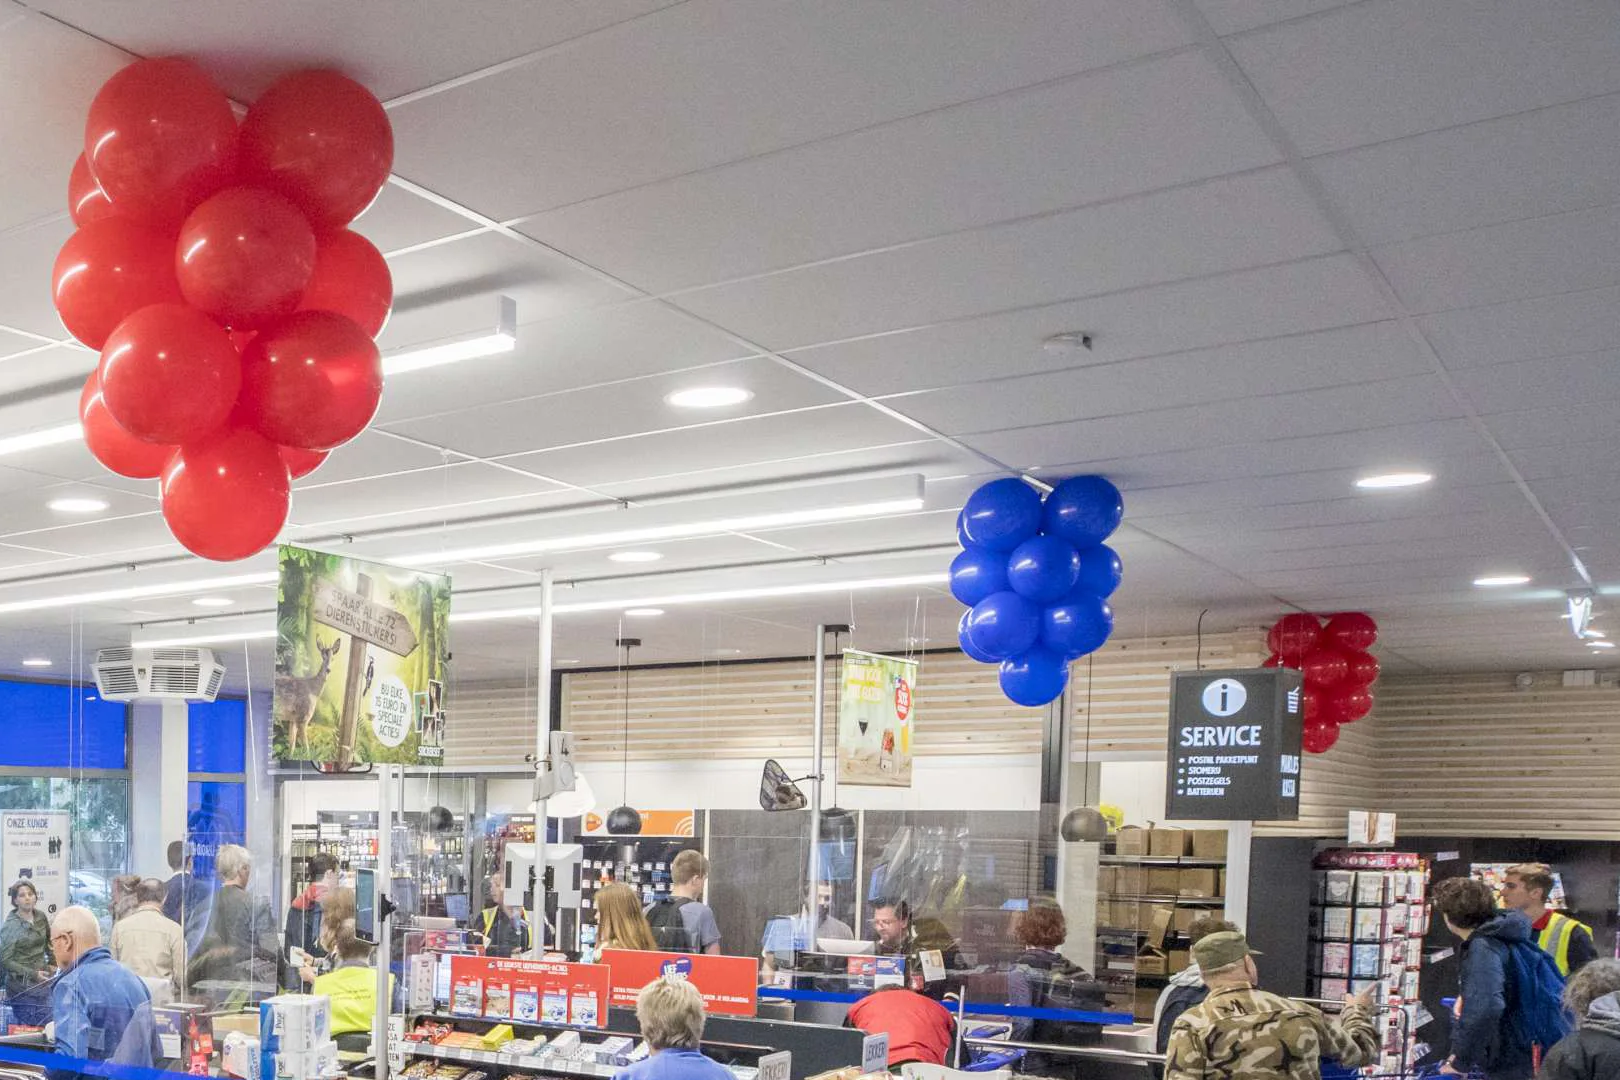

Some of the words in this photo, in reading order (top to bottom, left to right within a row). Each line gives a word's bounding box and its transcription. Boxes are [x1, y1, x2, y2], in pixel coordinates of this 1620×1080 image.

[384, 613, 396, 629] 72
[1180, 725, 1262, 746] SERVICE
[1187, 777, 1231, 786] POSTZEGELS
